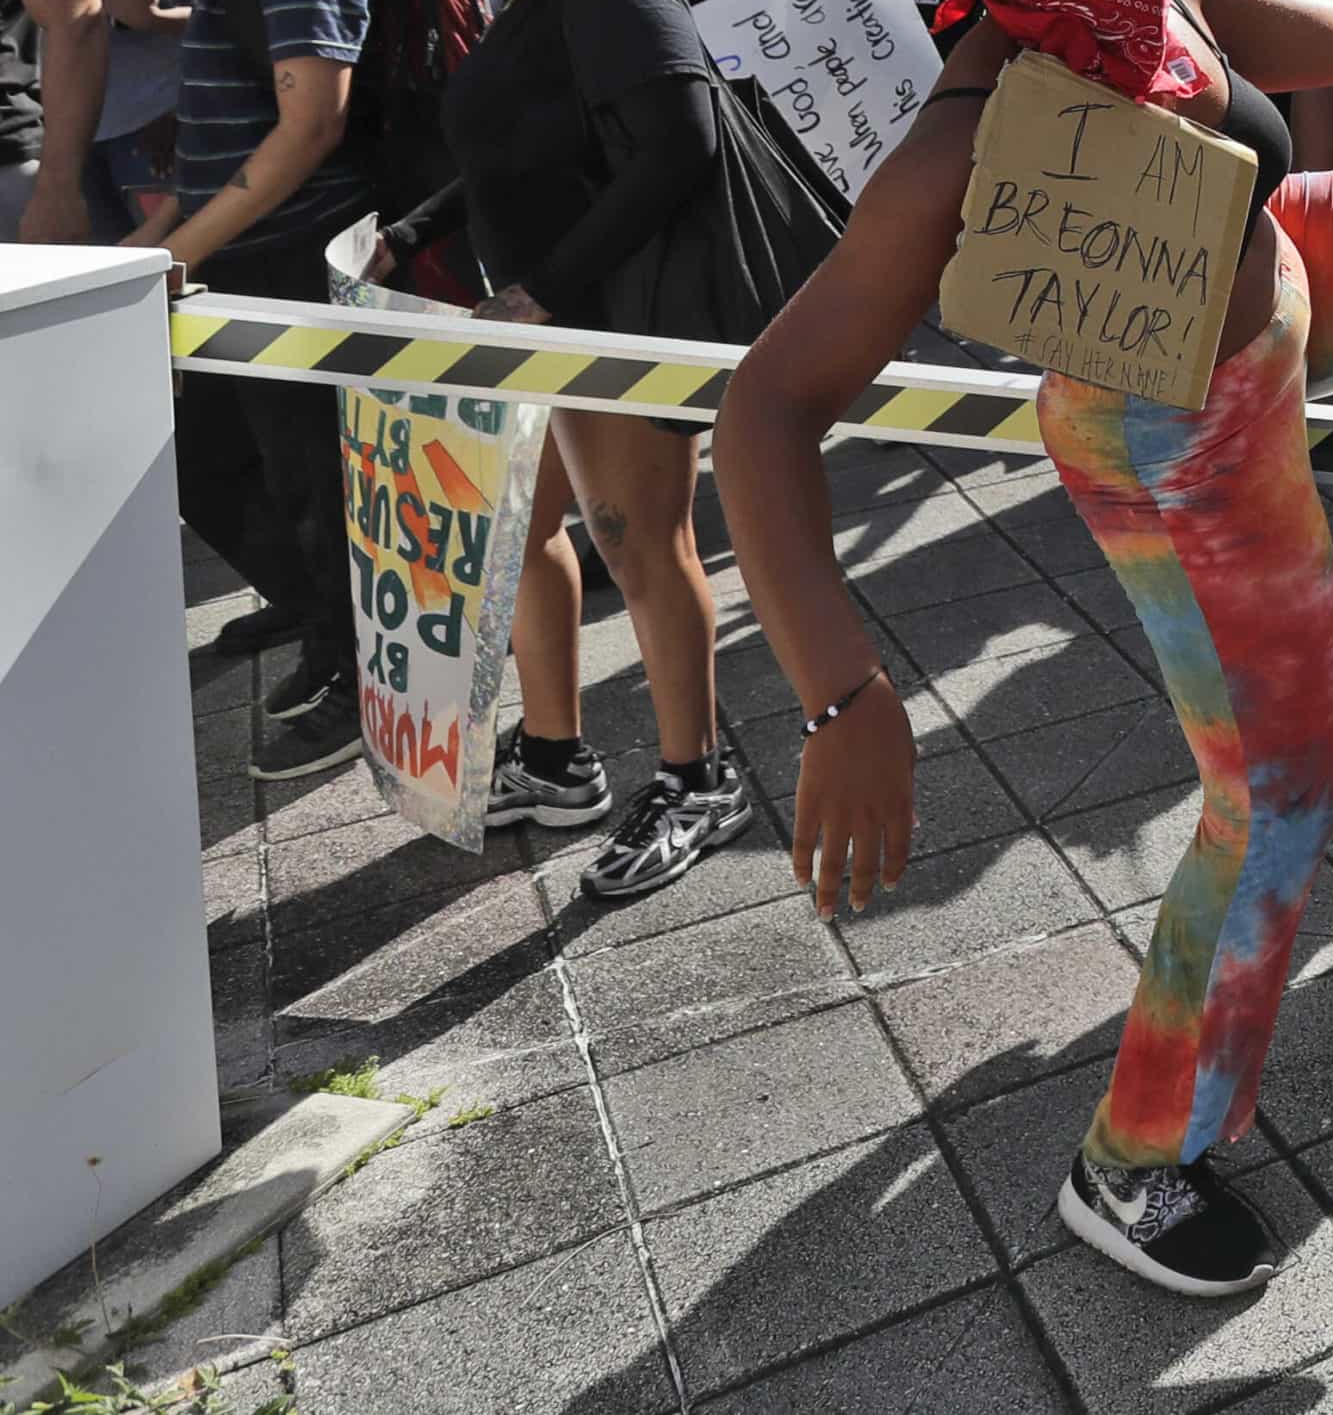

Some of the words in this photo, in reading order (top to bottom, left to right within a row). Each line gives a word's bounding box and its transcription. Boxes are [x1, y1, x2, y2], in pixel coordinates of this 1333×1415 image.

[1041, 101, 1116, 181] I
[1134, 134, 1206, 240] AM
[974, 181, 1209, 307] BREONNA
[992, 268, 1196, 362] TAYLOR!
[367, 631, 410, 694] BY
